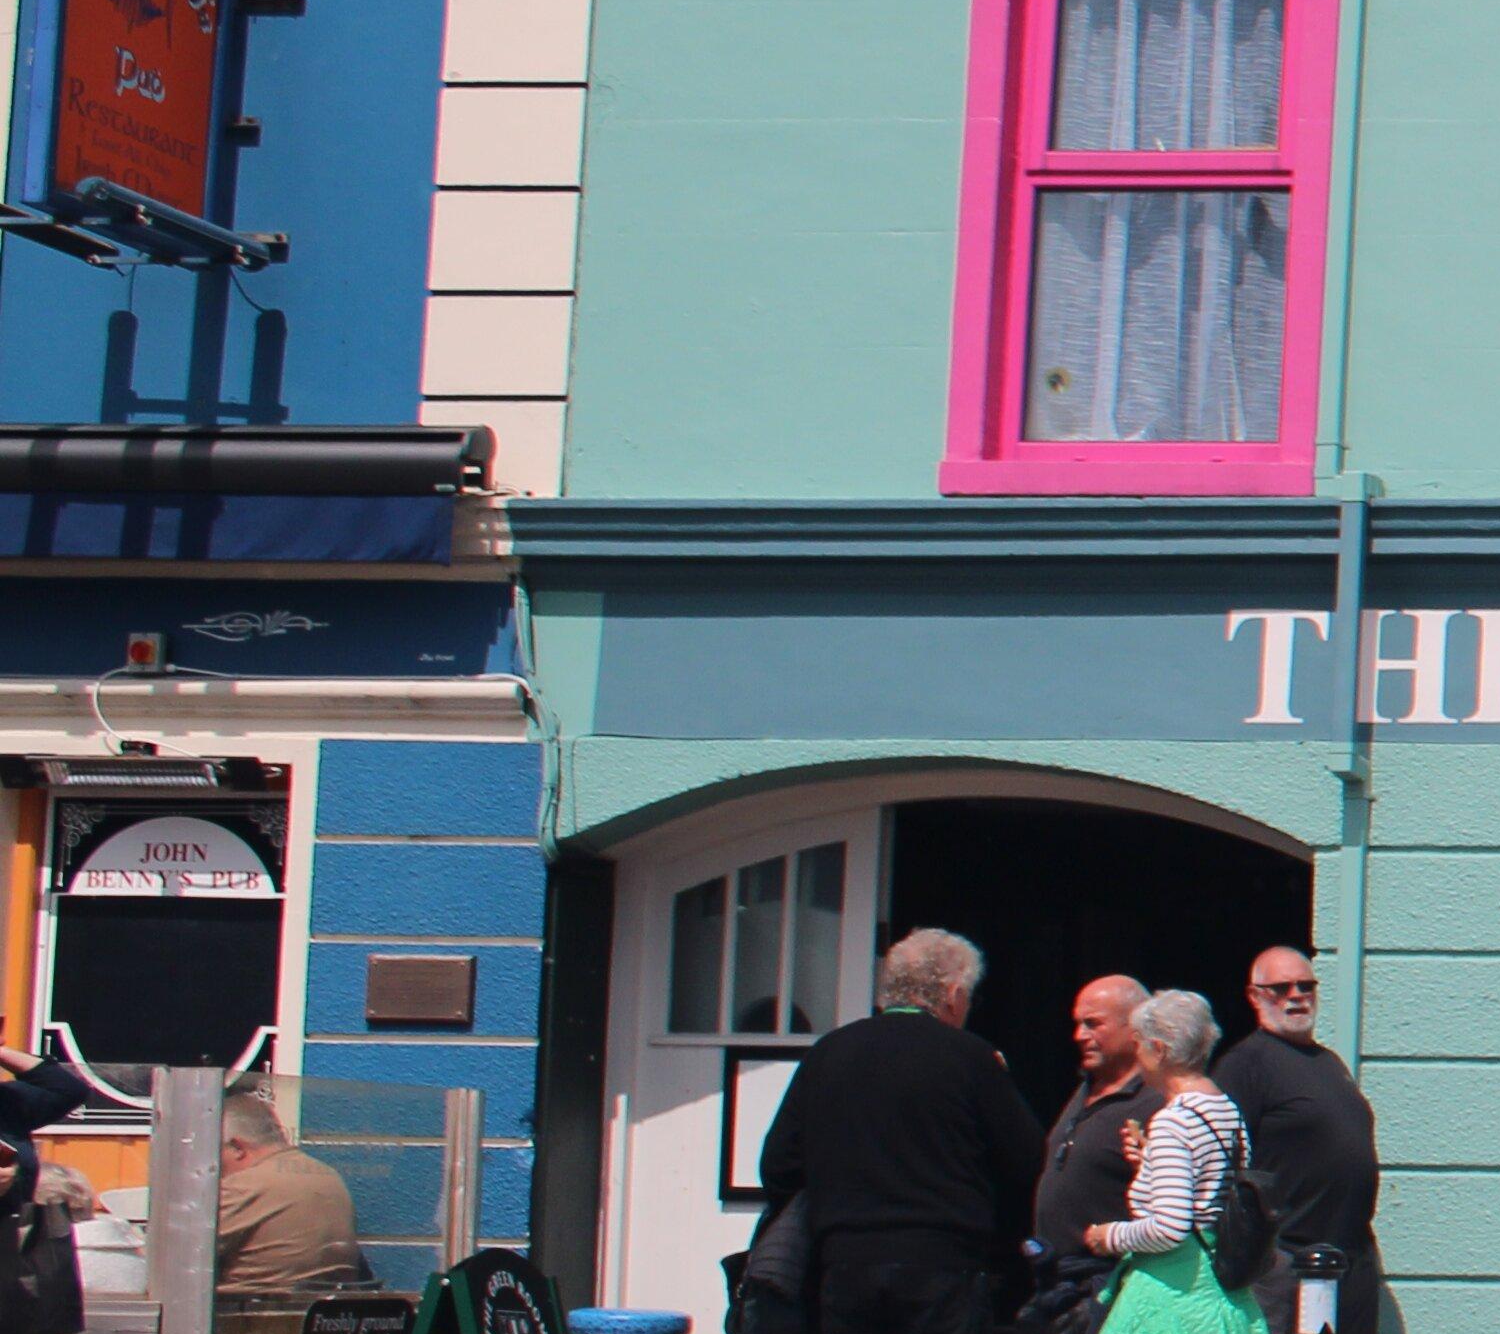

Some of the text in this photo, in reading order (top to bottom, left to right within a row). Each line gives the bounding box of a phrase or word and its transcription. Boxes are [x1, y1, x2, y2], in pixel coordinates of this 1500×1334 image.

[113, 46, 167, 105] Pub
[140, 842, 208, 864] JOHN
[86, 870, 260, 890] BENNY'S PUB
